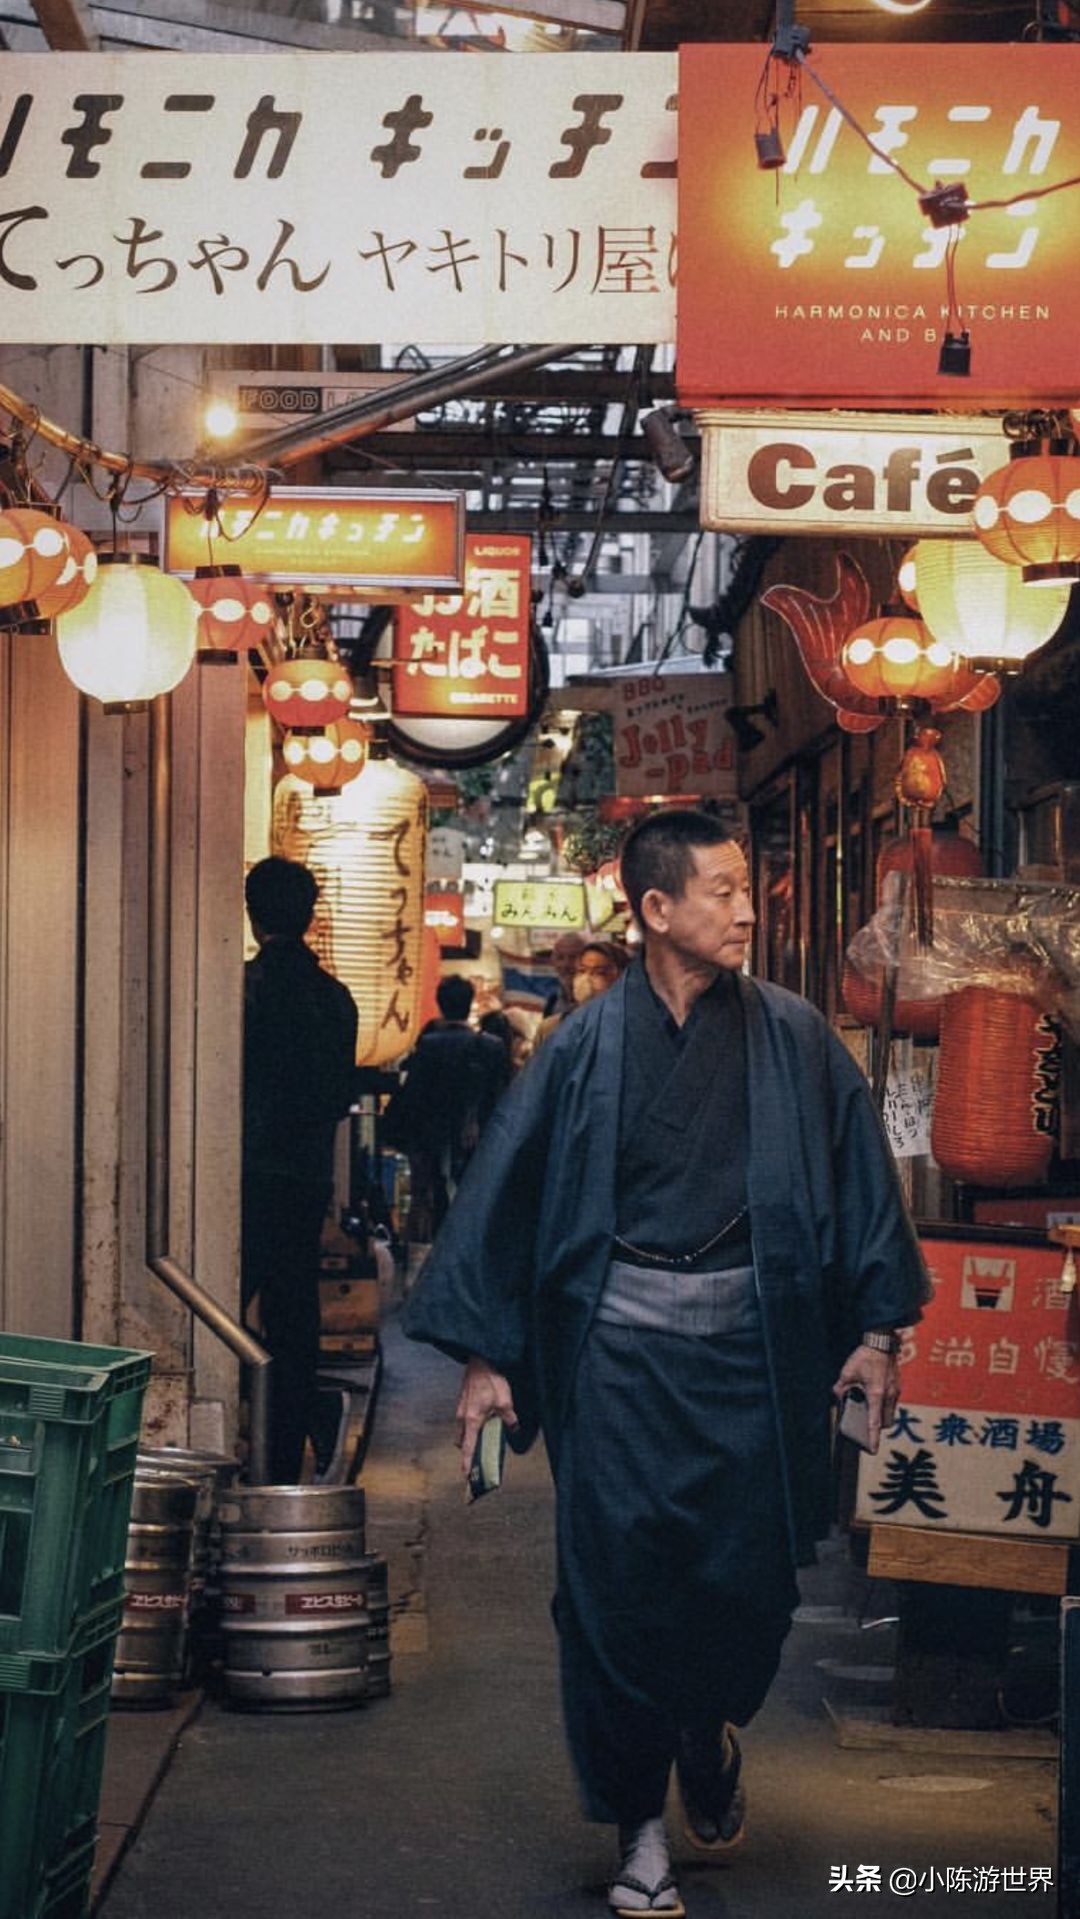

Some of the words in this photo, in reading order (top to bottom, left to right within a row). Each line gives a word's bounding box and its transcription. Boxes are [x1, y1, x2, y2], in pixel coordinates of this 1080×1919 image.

[782, 105, 1061, 174] ハモニカ
[0, 205, 331, 295] てっちゃん
[775, 304, 926, 320] HARMONICA
[940, 304, 1051, 320] KITCHEN
[860, 327, 911, 342] AND
[748, 442, 982, 512] Café
[406, 625, 522, 680] たばこ
[888, 1407, 1067, 1454] 大衆酒場
